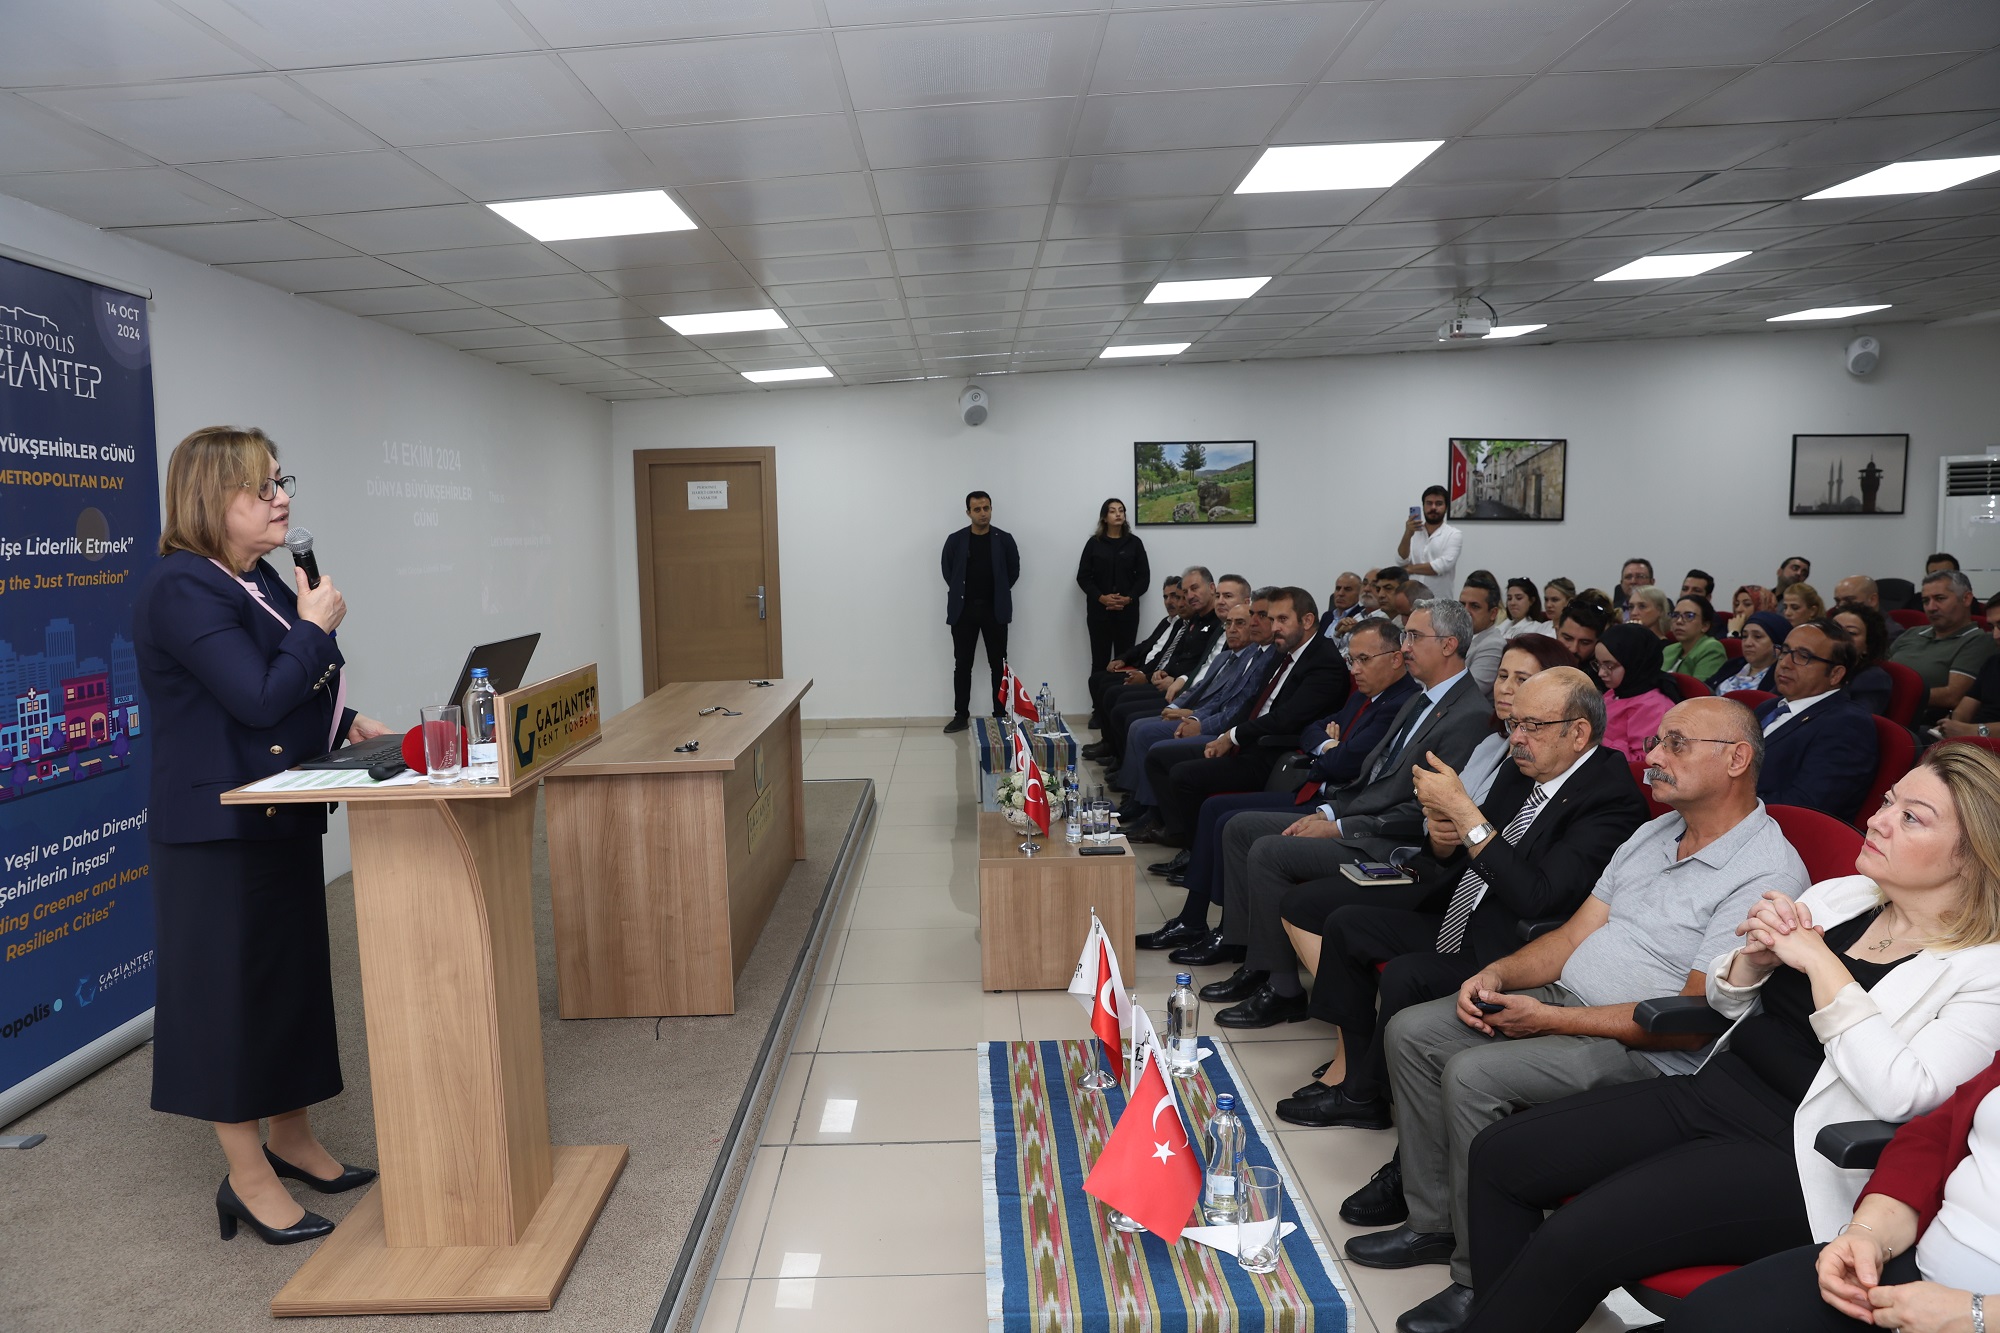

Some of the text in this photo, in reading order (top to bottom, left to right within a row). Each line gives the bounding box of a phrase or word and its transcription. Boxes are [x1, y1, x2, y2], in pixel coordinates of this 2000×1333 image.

[106, 301, 140, 321] 14 OCT
[117, 323, 140, 341] 2024
[100, 443, 135, 463] GÜNÜ
[382, 439, 462, 472] 14 EKİM 2024
[101, 475, 124, 490] DAY
[366, 475, 473, 504] DÜNYA BÜYÜKŞEHİRLER
[413, 507, 439, 527] GÜNÜ
[26, 536, 82, 555] Liderlik
[9, 575, 31, 591] the
[34, 574, 63, 589] Just
[536, 686, 596, 732] GAZİANTEP
[537, 728, 559, 749] KENT
[4, 808, 148, 872] Yeşil ve Daha Dirençli
[33, 888, 89, 921] Greener
[92, 874, 117, 897] and
[120, 864, 149, 886] More
[6, 922, 69, 962] Resilient
[99, 978, 119, 993] KENT
[0, 1003, 51, 1039] opolis
